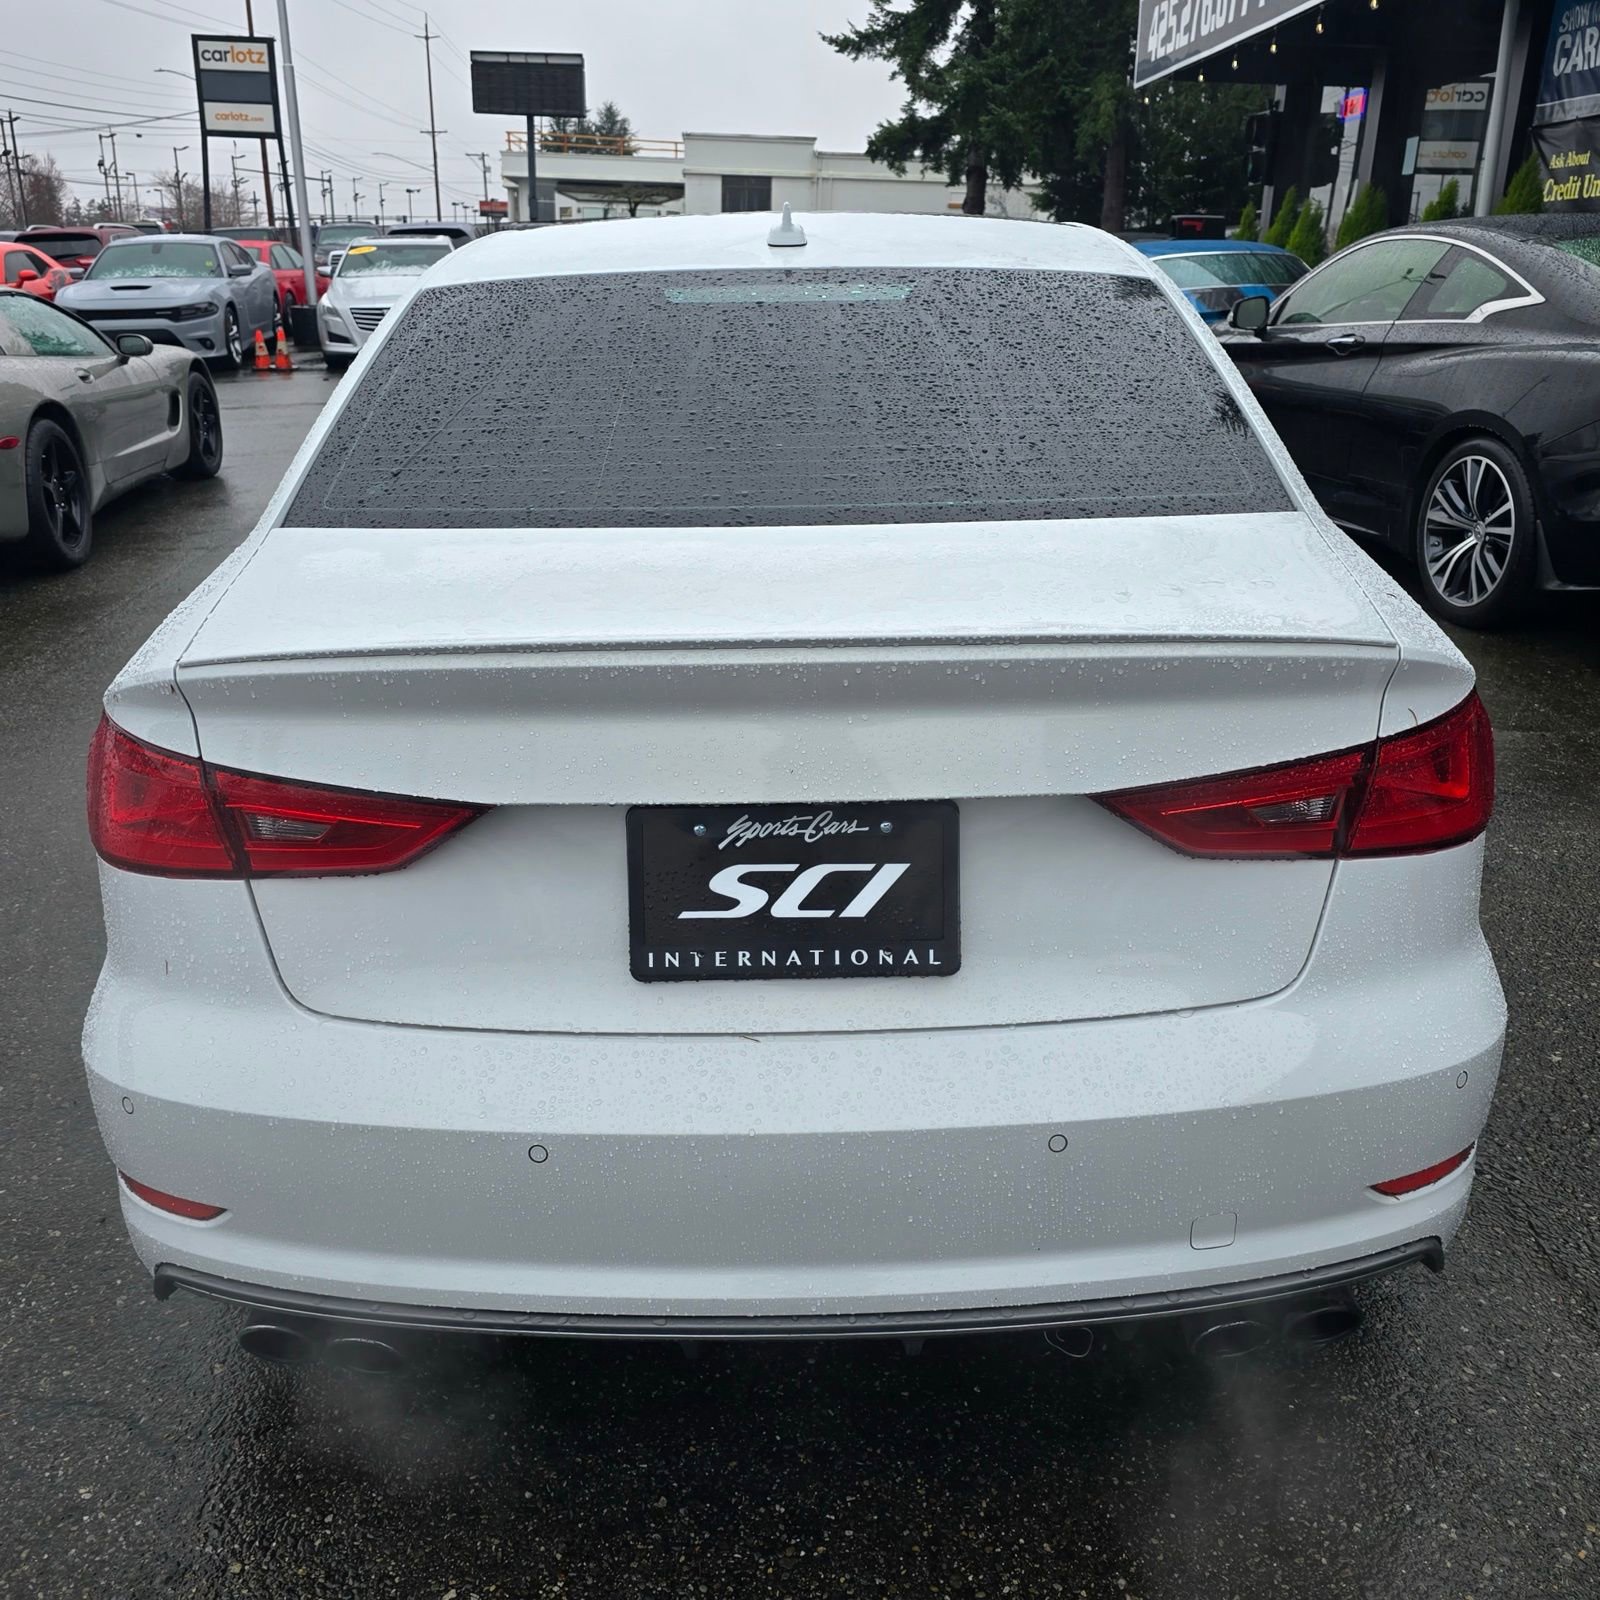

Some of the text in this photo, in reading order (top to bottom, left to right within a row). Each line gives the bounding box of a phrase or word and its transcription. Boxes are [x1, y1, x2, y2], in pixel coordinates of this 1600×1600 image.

[1558, 4, 1590, 33] SHOW
[201, 45, 266, 64] carlotz
[1549, 150, 1590, 169] Ask About
[1543, 176, 1581, 202] Credit
[718, 811, 869, 850] Sports Cars
[677, 863, 911, 919] SCI
[648, 949, 941, 967] INTERNATIONAL
